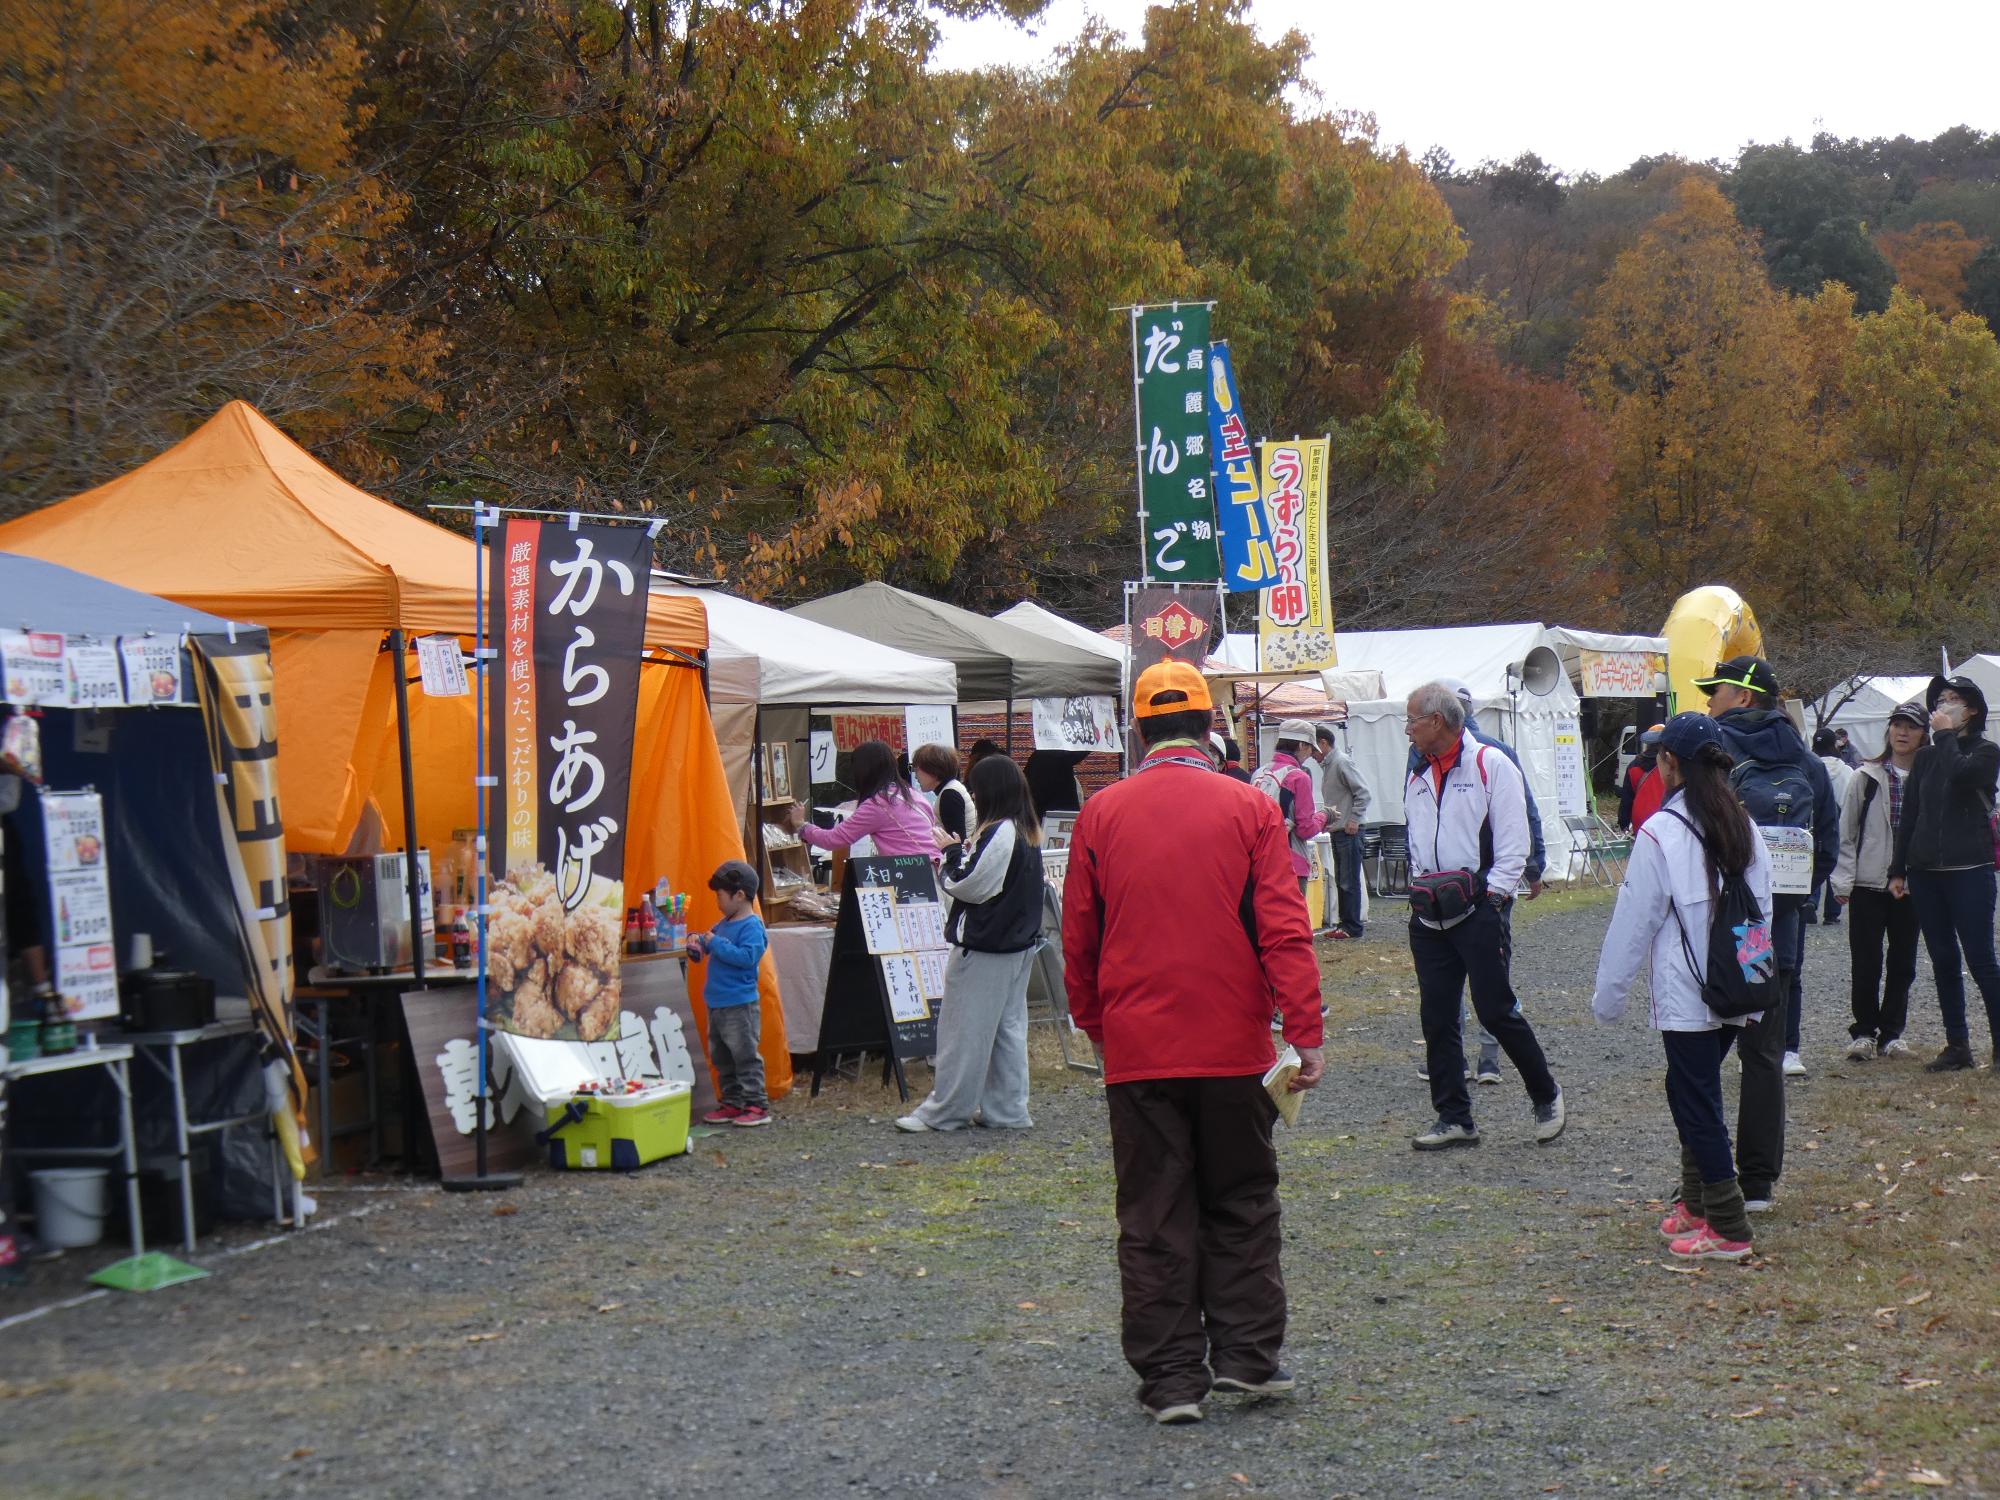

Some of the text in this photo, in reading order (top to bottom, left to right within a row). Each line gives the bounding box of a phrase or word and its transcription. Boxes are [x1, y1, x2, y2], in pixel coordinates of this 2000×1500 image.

[1144, 320, 1186, 572] だんご
[1184, 348, 1211, 541] 高麗郷名物
[1145, 613, 1204, 640] 日替り
[509, 541, 532, 848] 厳選素材を使った、こだわりの味
[548, 538, 635, 910] からあげ
[865, 865, 903, 884] 本日の
[861, 893, 877, 949] メニューです
[878, 891, 892, 919] 本日
[886, 958, 899, 995] ポテト
[902, 958, 920, 1004] からあげ
